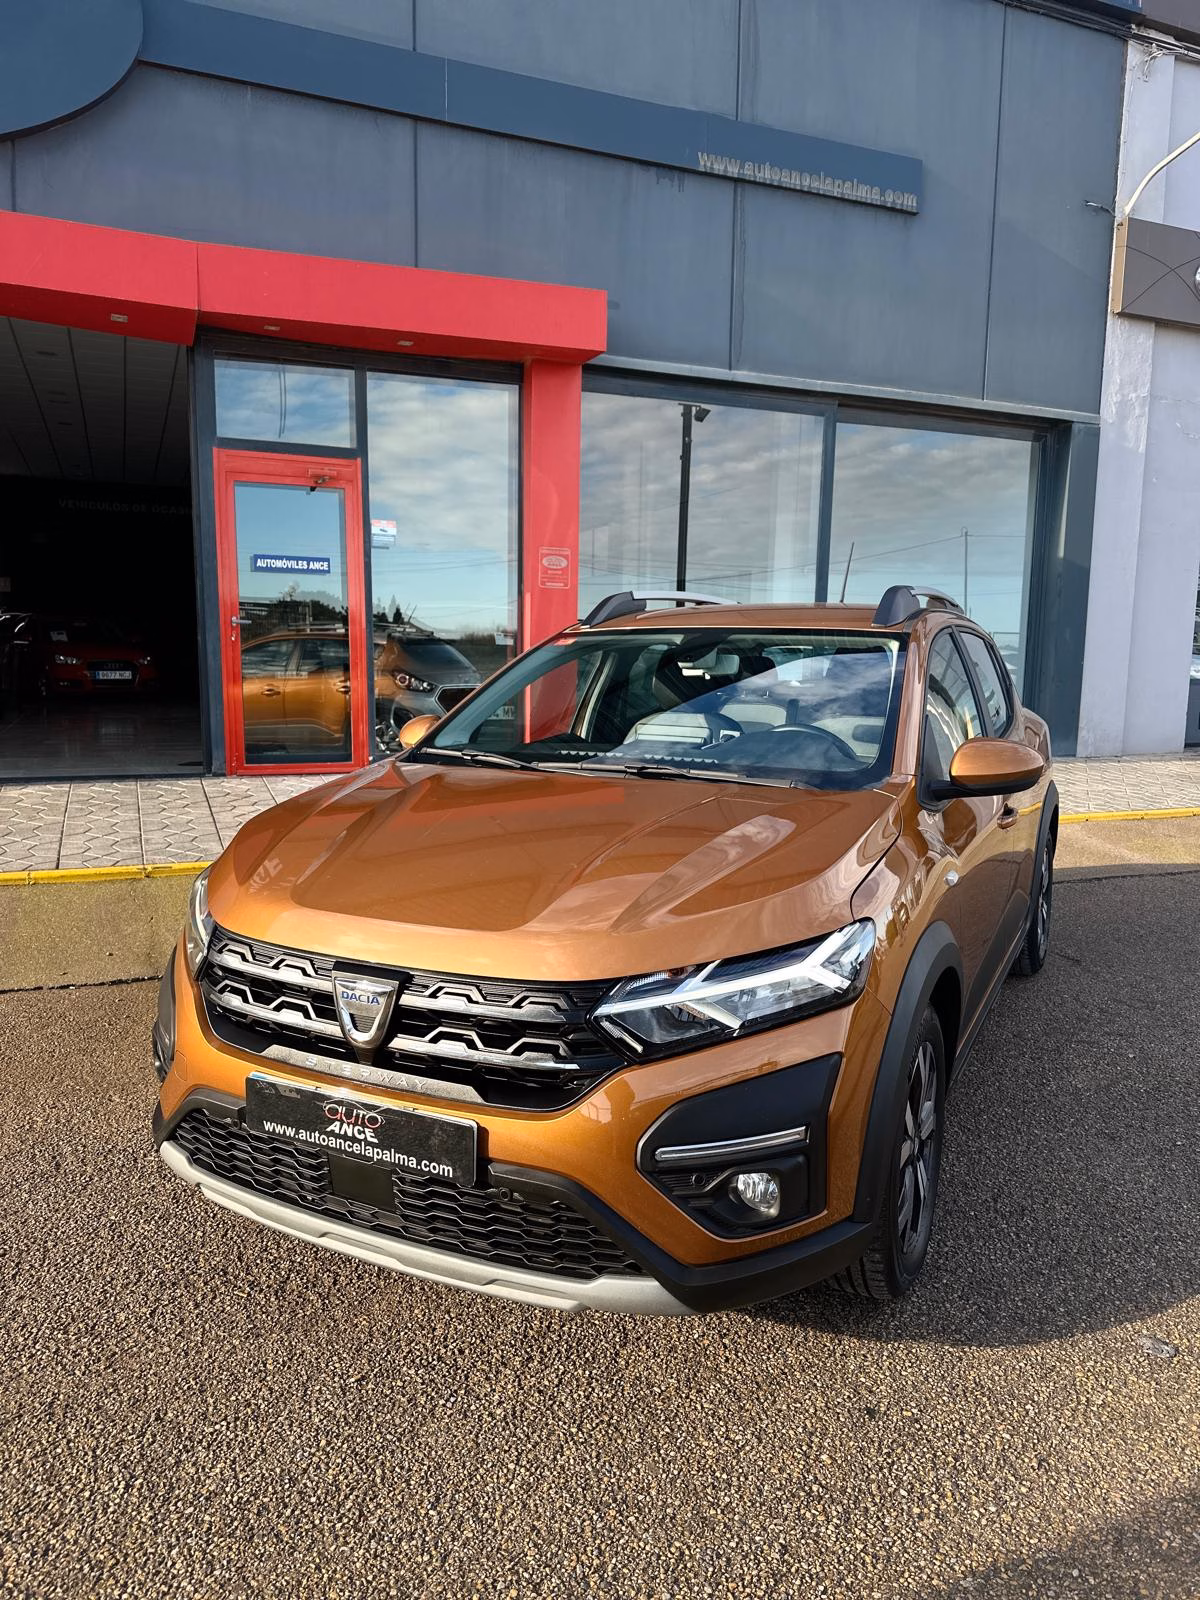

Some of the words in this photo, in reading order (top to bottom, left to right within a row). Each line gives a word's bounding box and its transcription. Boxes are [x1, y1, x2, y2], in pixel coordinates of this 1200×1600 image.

[256, 558, 308, 570] AUTOMÓVILES
[309, 561, 329, 570] ANCE
[341, 991, 380, 1005] DACIA
[305, 1055, 427, 1090] STEPWAY
[326, 1121, 379, 1143] ANCE
[263, 1120, 454, 1178] www.autoancelapalma.com
